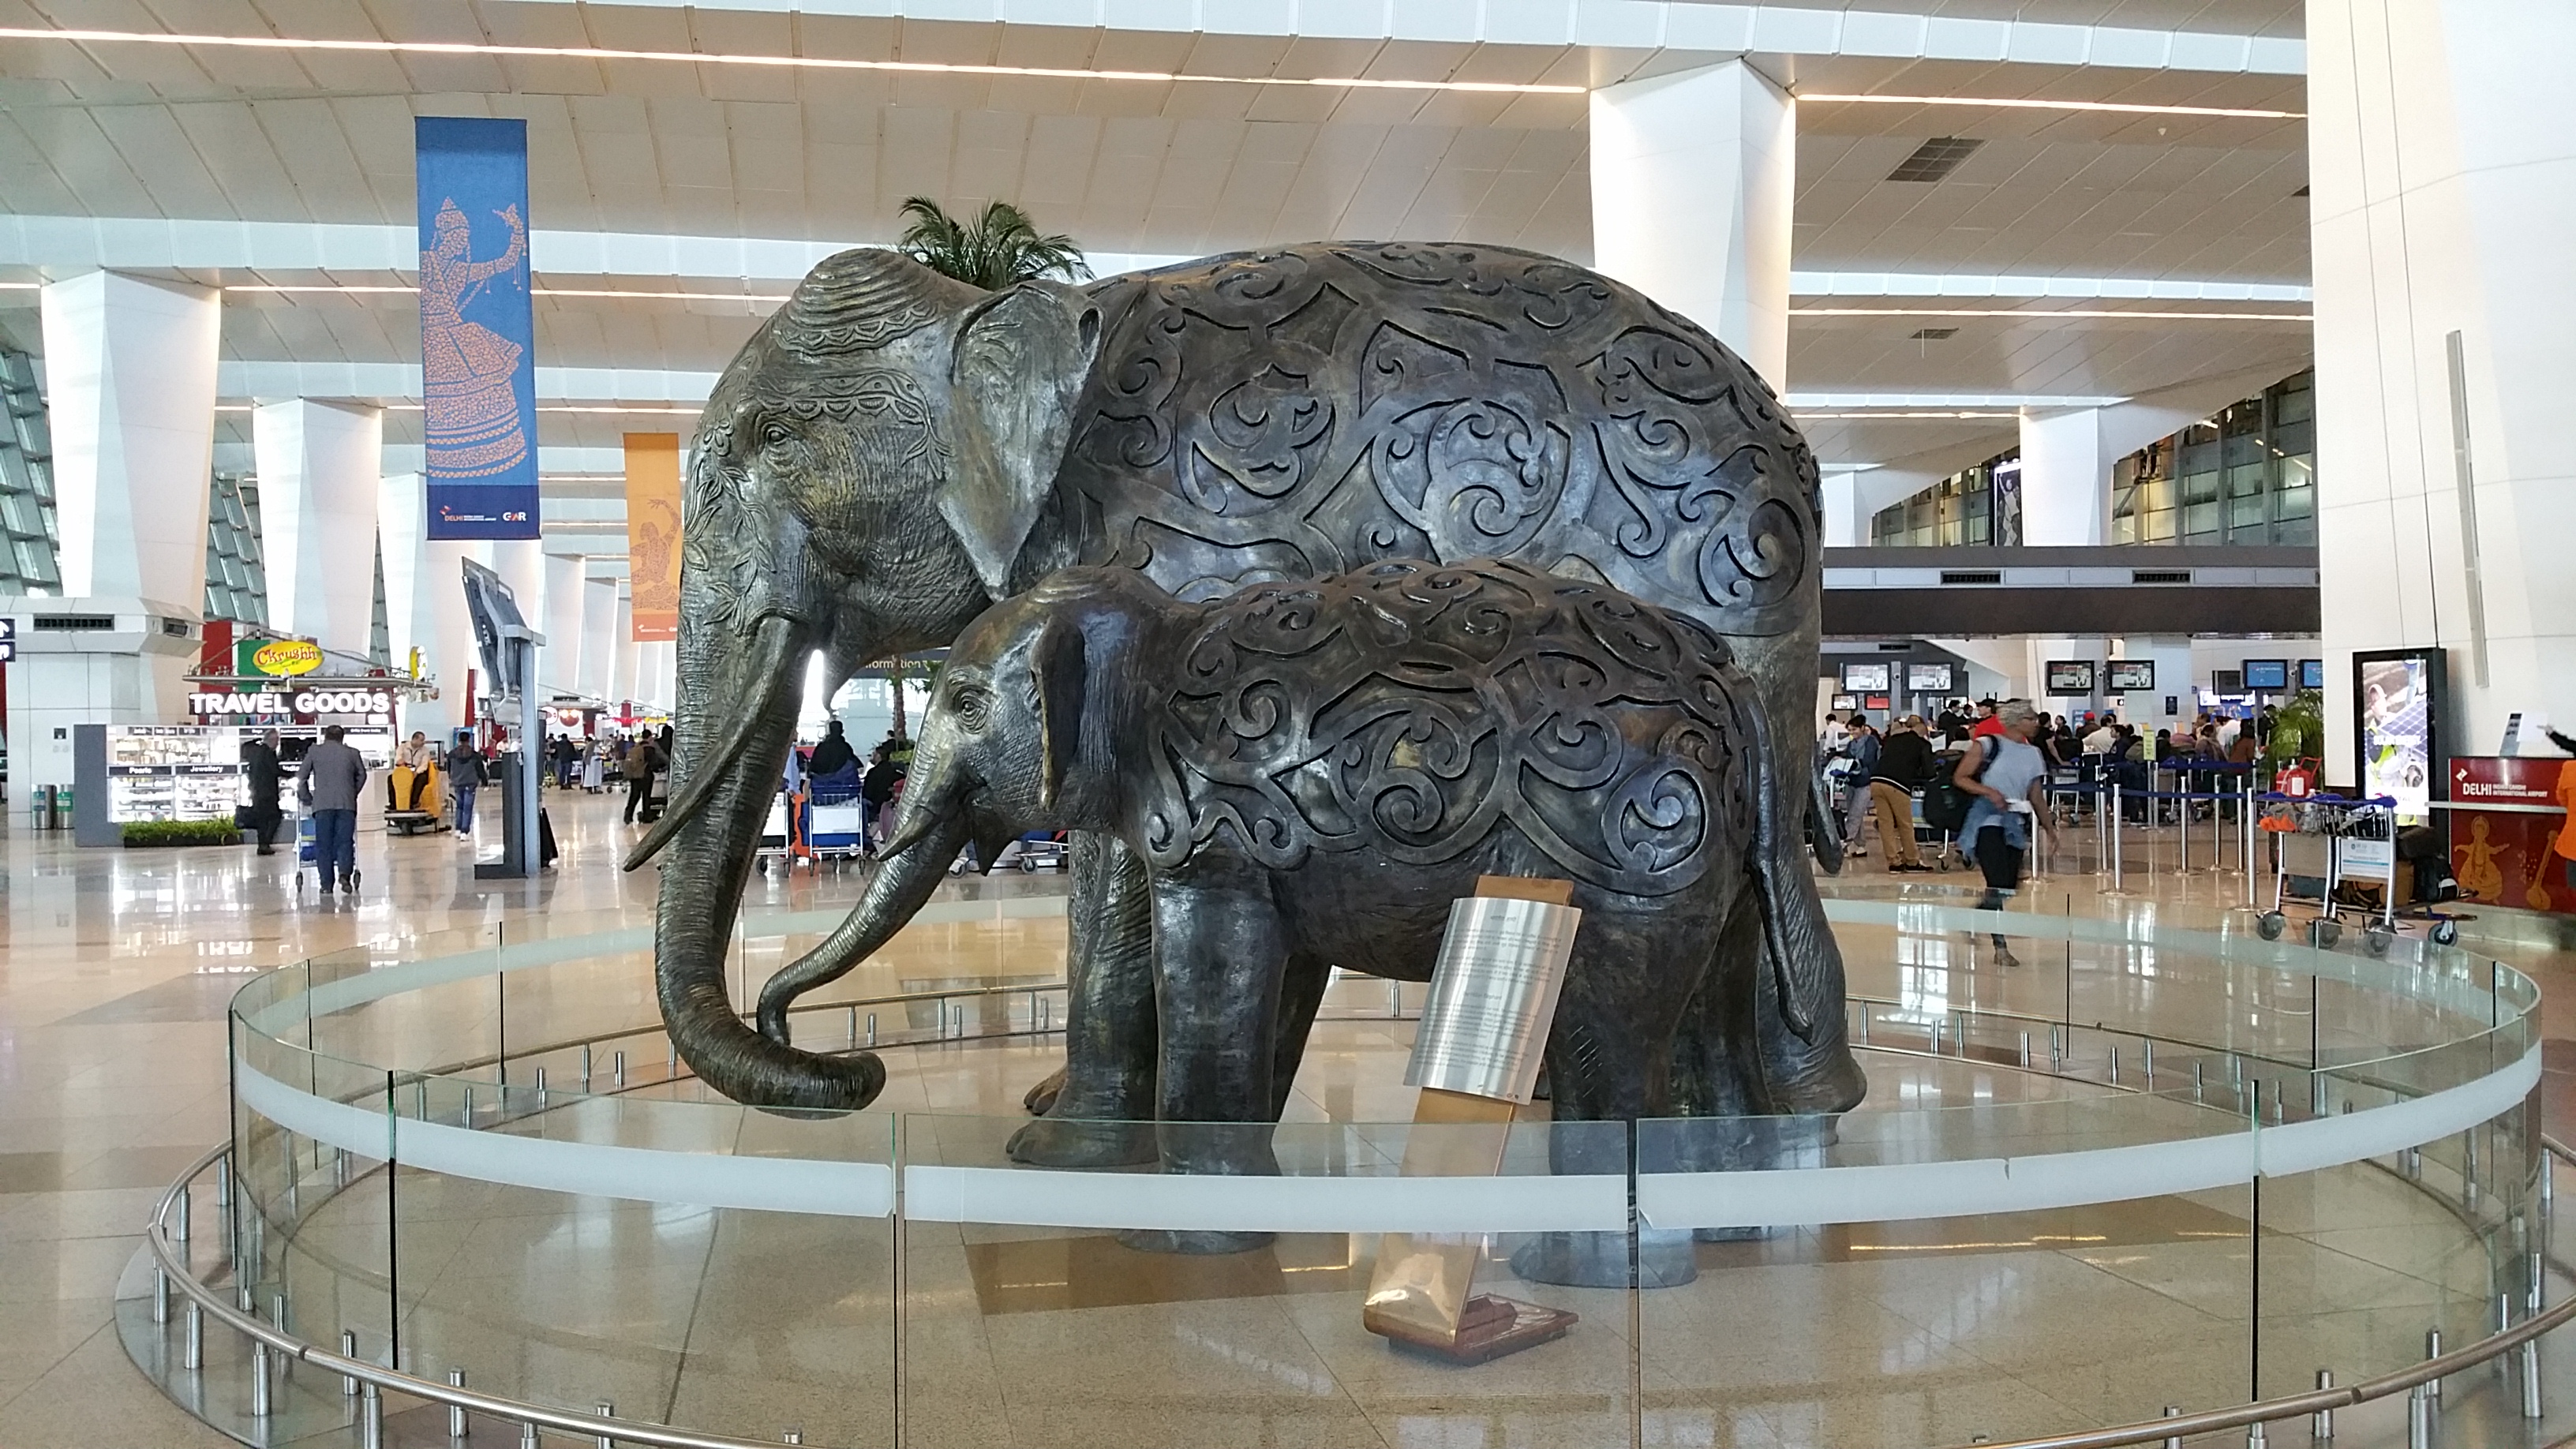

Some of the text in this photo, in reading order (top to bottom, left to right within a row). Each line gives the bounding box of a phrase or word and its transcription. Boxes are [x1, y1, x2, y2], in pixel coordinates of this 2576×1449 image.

[257, 646, 316, 665] Ckrushh
[189, 692, 390, 713] TRAVEL GOODS
[2462, 783, 2492, 796] DELHI
